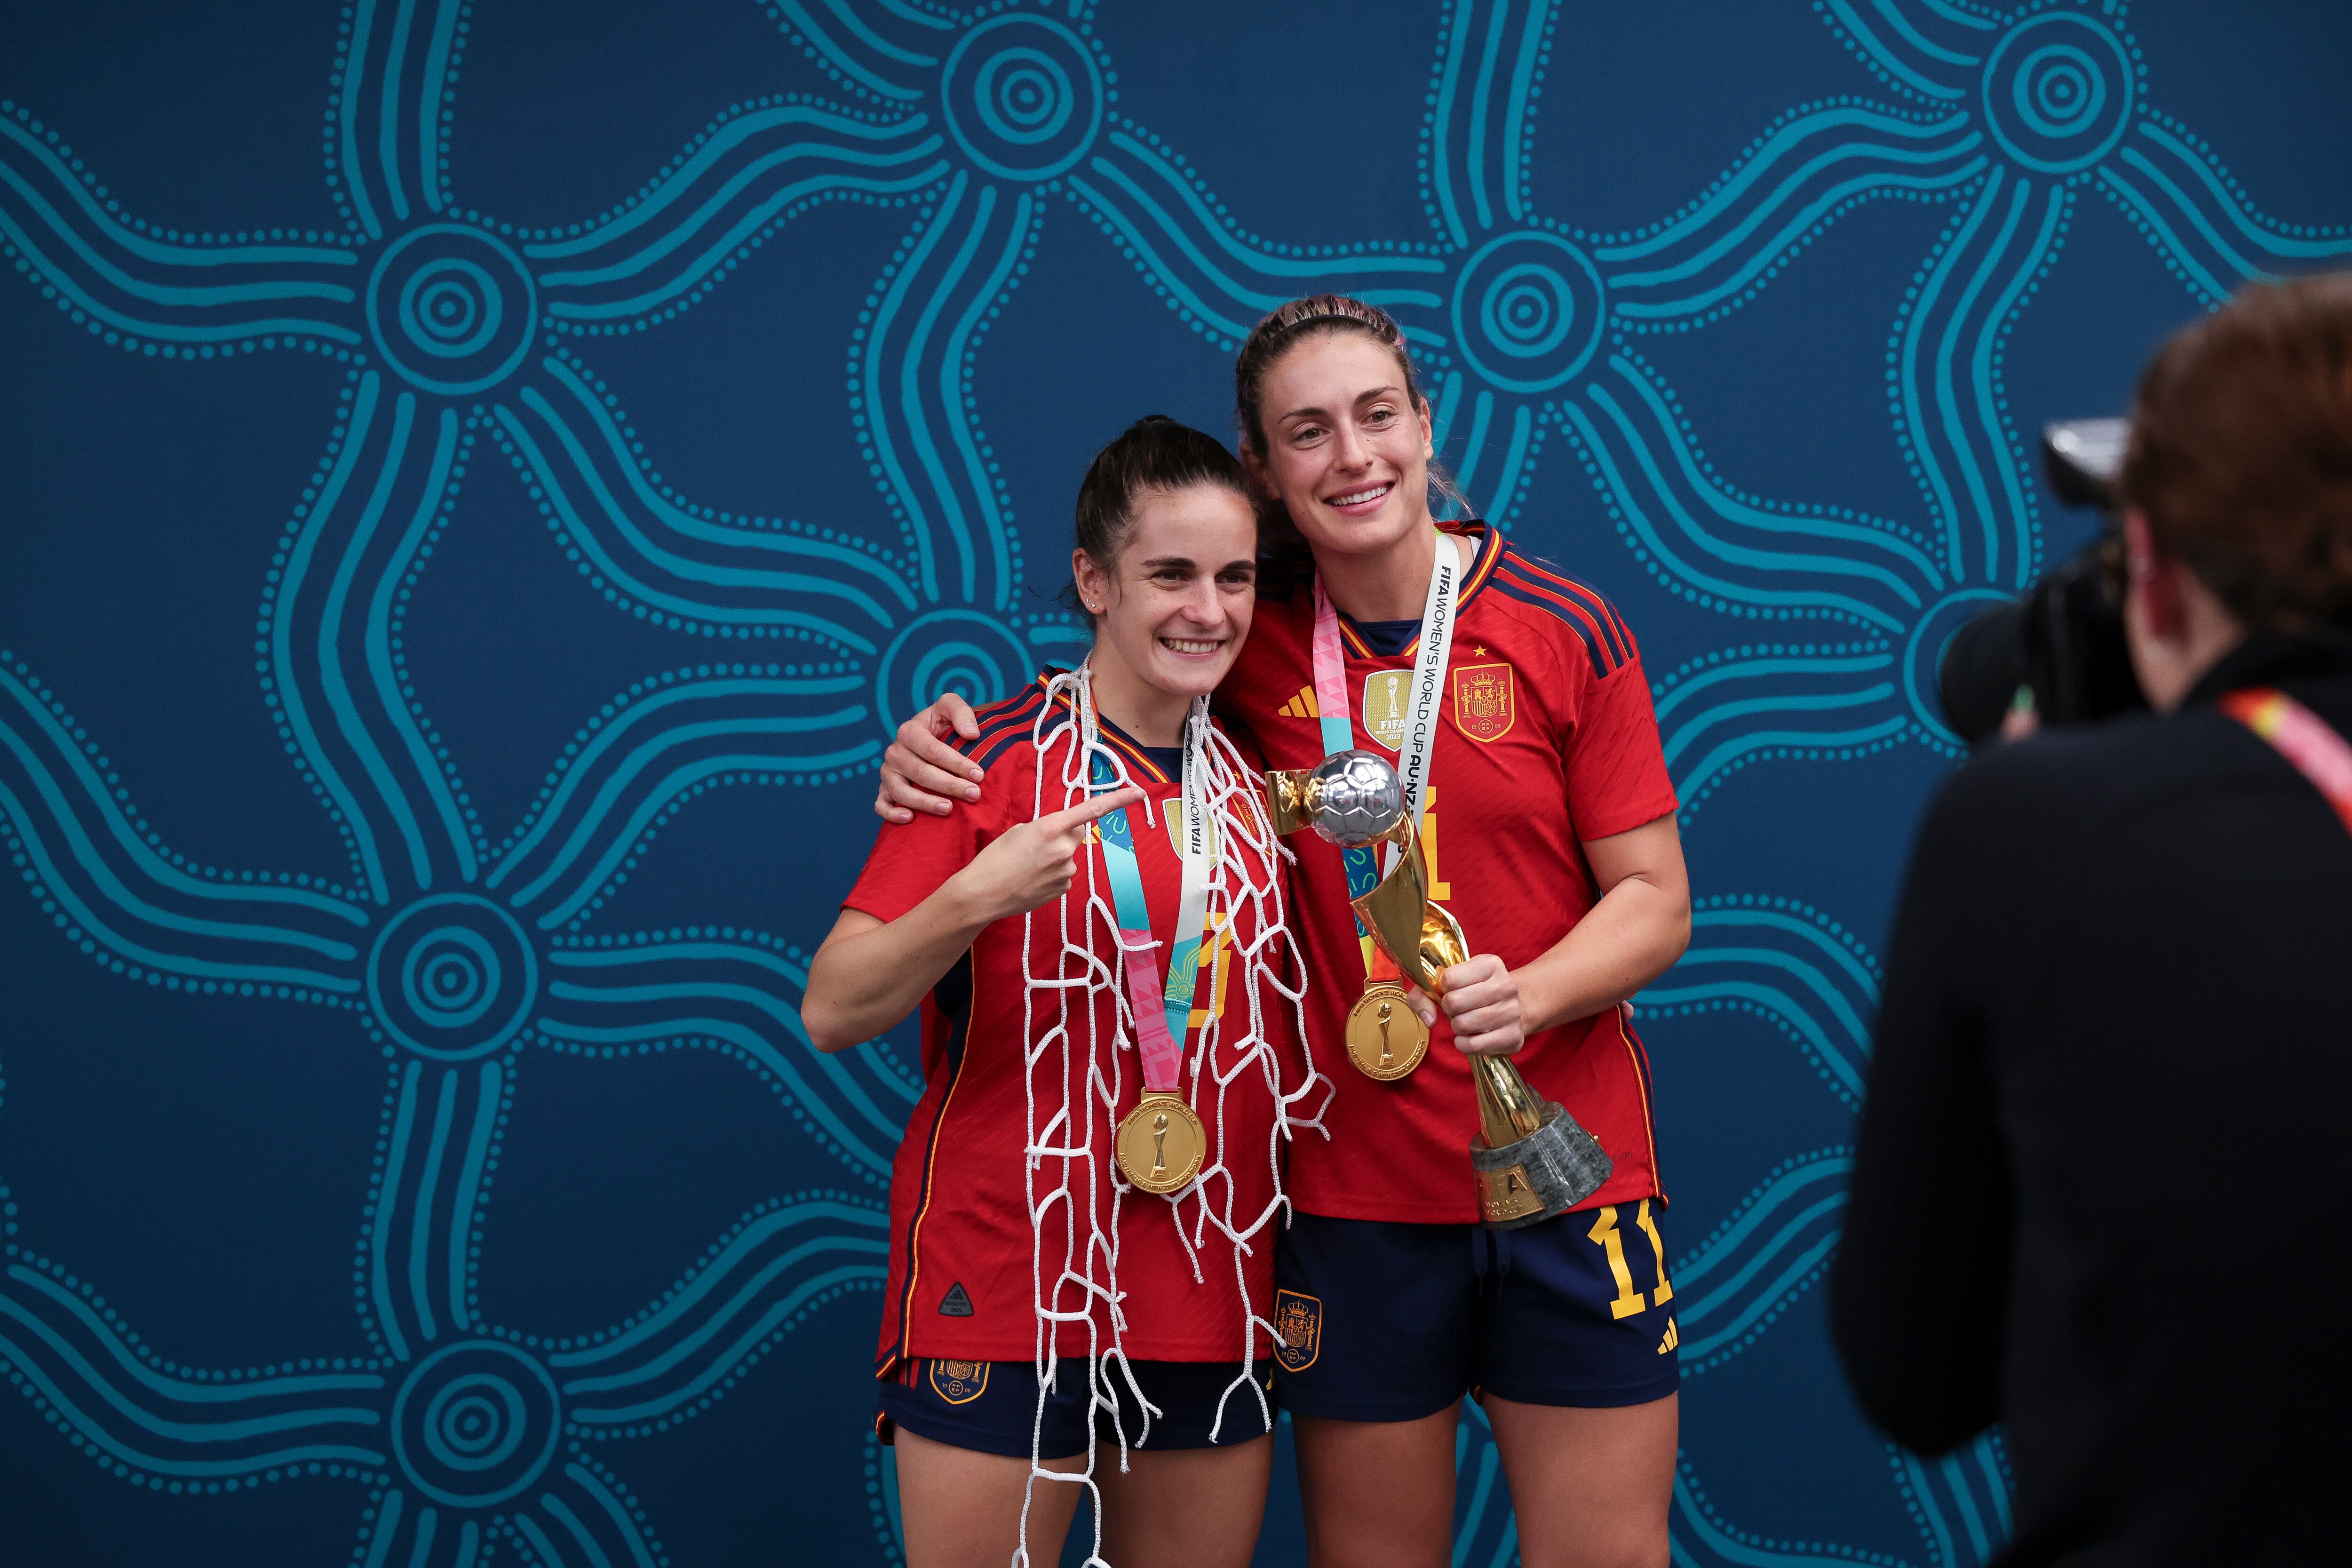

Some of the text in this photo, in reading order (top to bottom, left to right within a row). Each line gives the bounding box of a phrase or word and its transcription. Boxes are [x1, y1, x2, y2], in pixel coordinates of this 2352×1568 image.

[1438, 565, 1451, 595] FIFA
[1427, 598, 1447, 665] WOMEN'S
[1417, 669, 1436, 720] WORLD
[1380, 719, 1406, 730] FIFA
[1413, 723, 1426, 753] CUP
[1192, 828, 1201, 854] FIFA
[1390, 989, 1407, 999] WORL
[1587, 1198, 1673, 1320] 11
